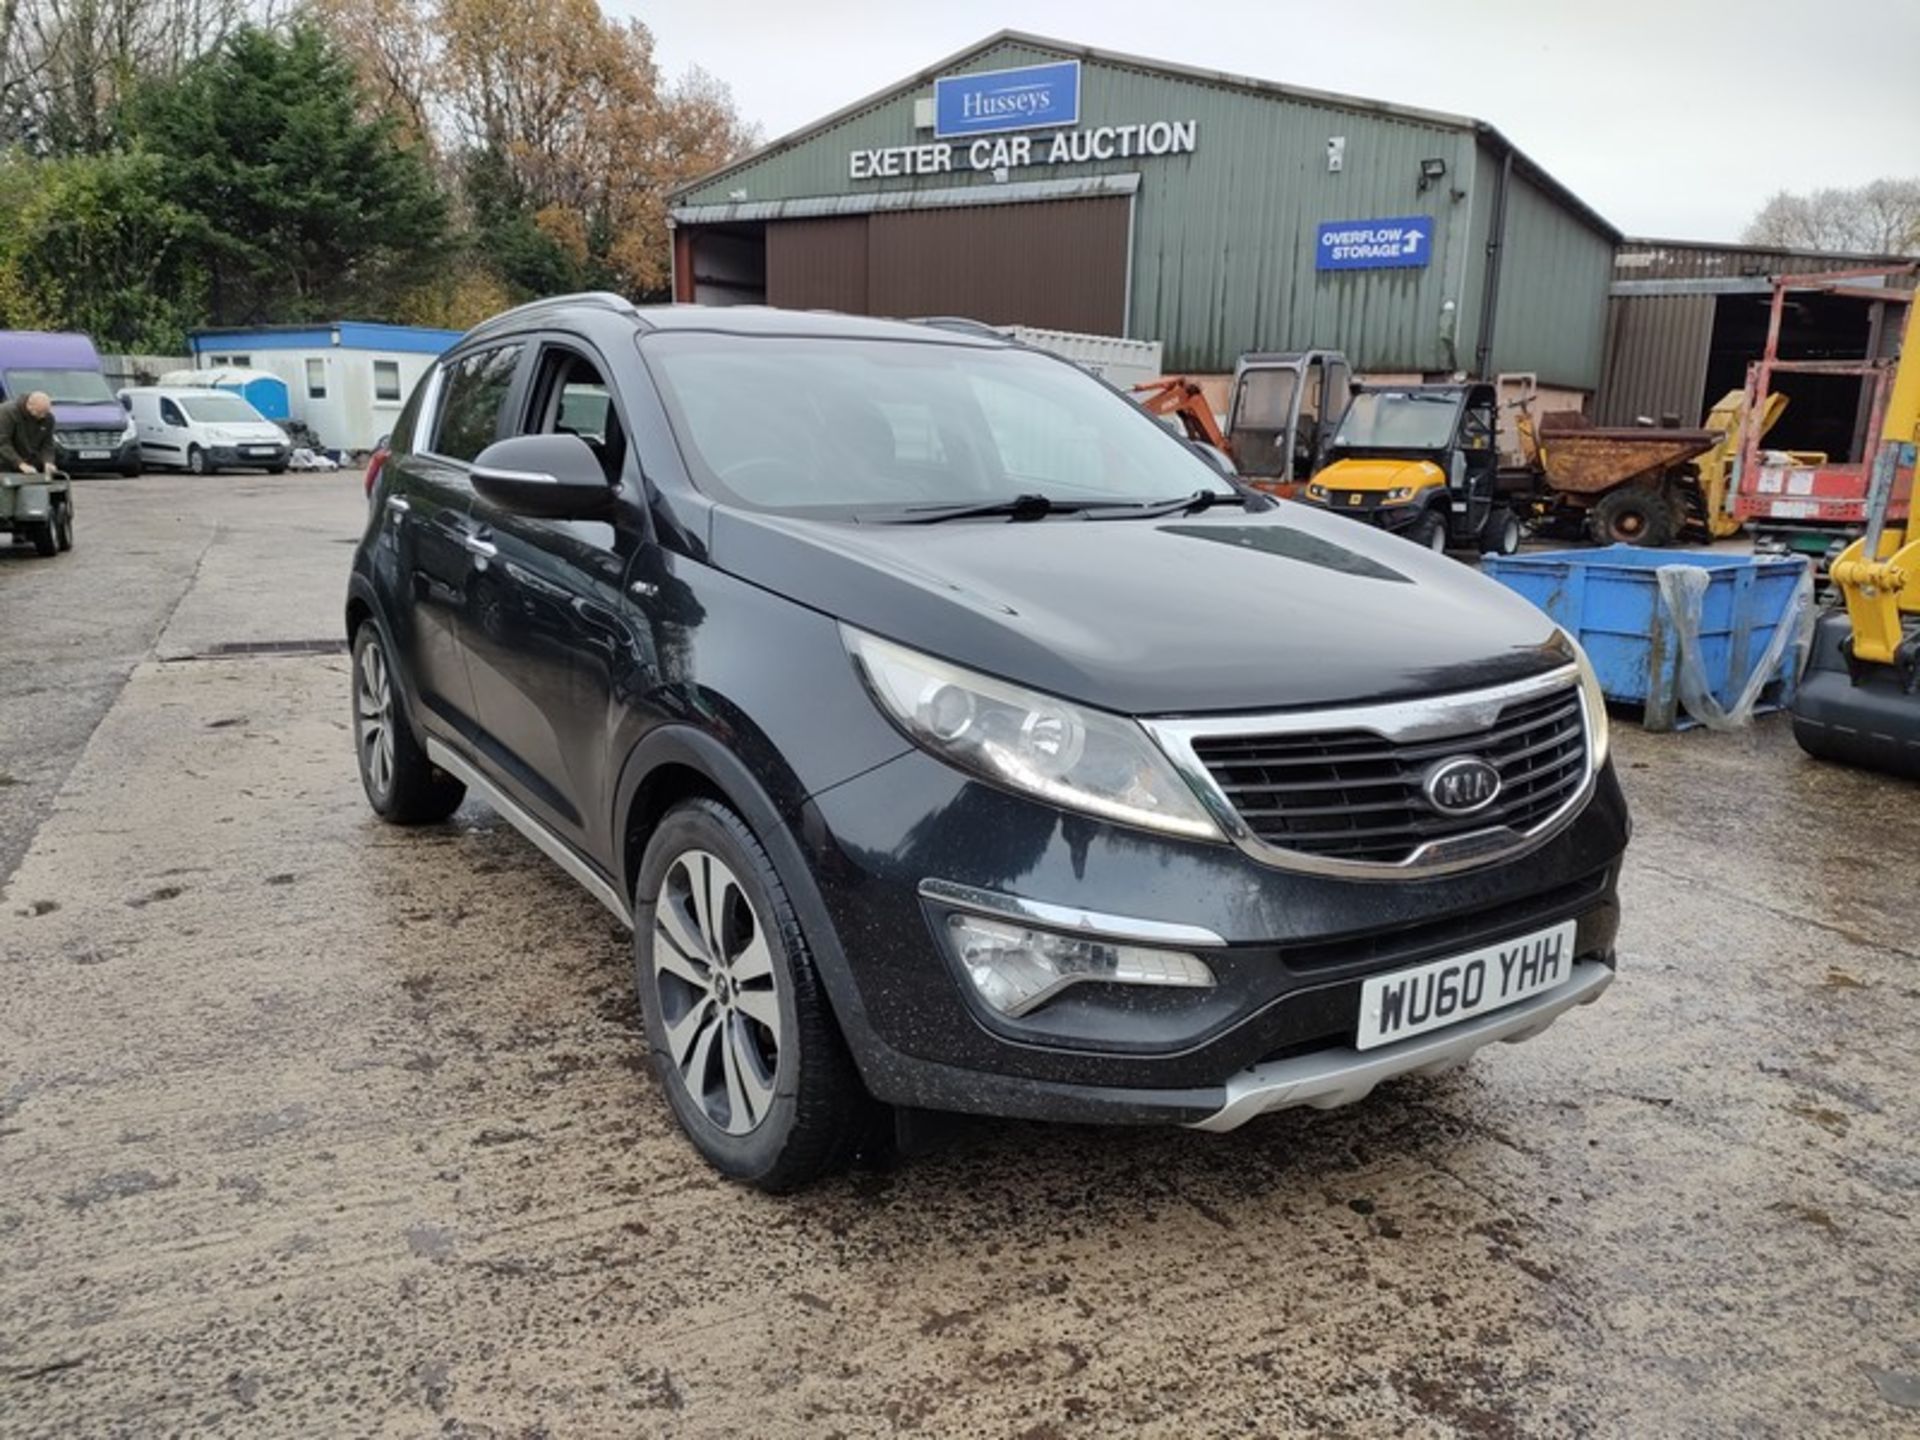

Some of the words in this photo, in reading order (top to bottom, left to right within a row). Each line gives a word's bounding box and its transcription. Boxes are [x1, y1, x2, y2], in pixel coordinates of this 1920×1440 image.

[962, 89, 1050, 116] Husseys
[850, 143, 952, 178] EXETER
[969, 137, 1031, 170] CAR
[1048, 120, 1197, 164] AUCTION
[1322, 229, 1402, 245] OVERFLOW
[1332, 244, 1400, 259] STORAGE
[1442, 770, 1491, 805] KIA
[1379, 959, 1486, 1035] WU60
[1499, 932, 1563, 997] YHH
